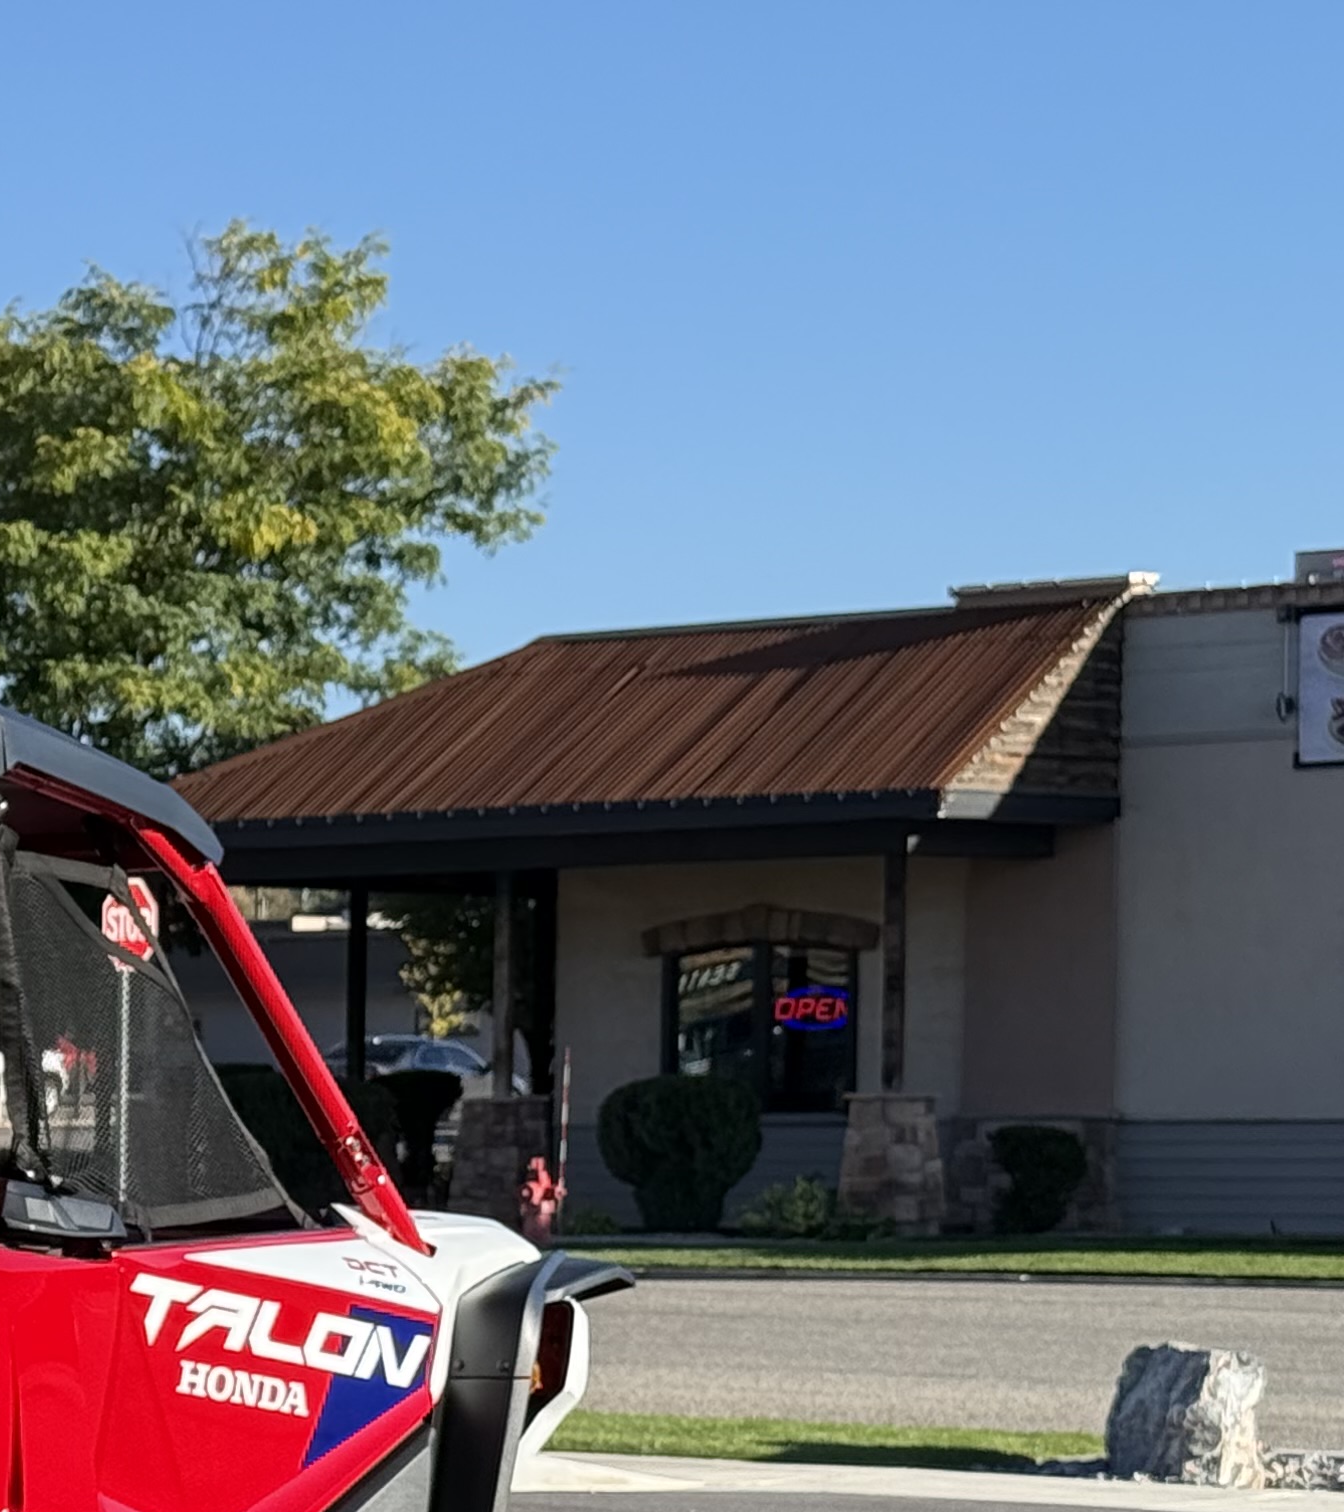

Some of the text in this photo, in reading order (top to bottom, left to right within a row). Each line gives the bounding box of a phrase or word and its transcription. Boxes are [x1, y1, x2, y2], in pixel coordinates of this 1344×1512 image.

[774, 997, 848, 1022] OPEN
[341, 1256, 398, 1279] DCT
[130, 1272, 431, 1389] TALON
[175, 1360, 310, 1418] HONDA
